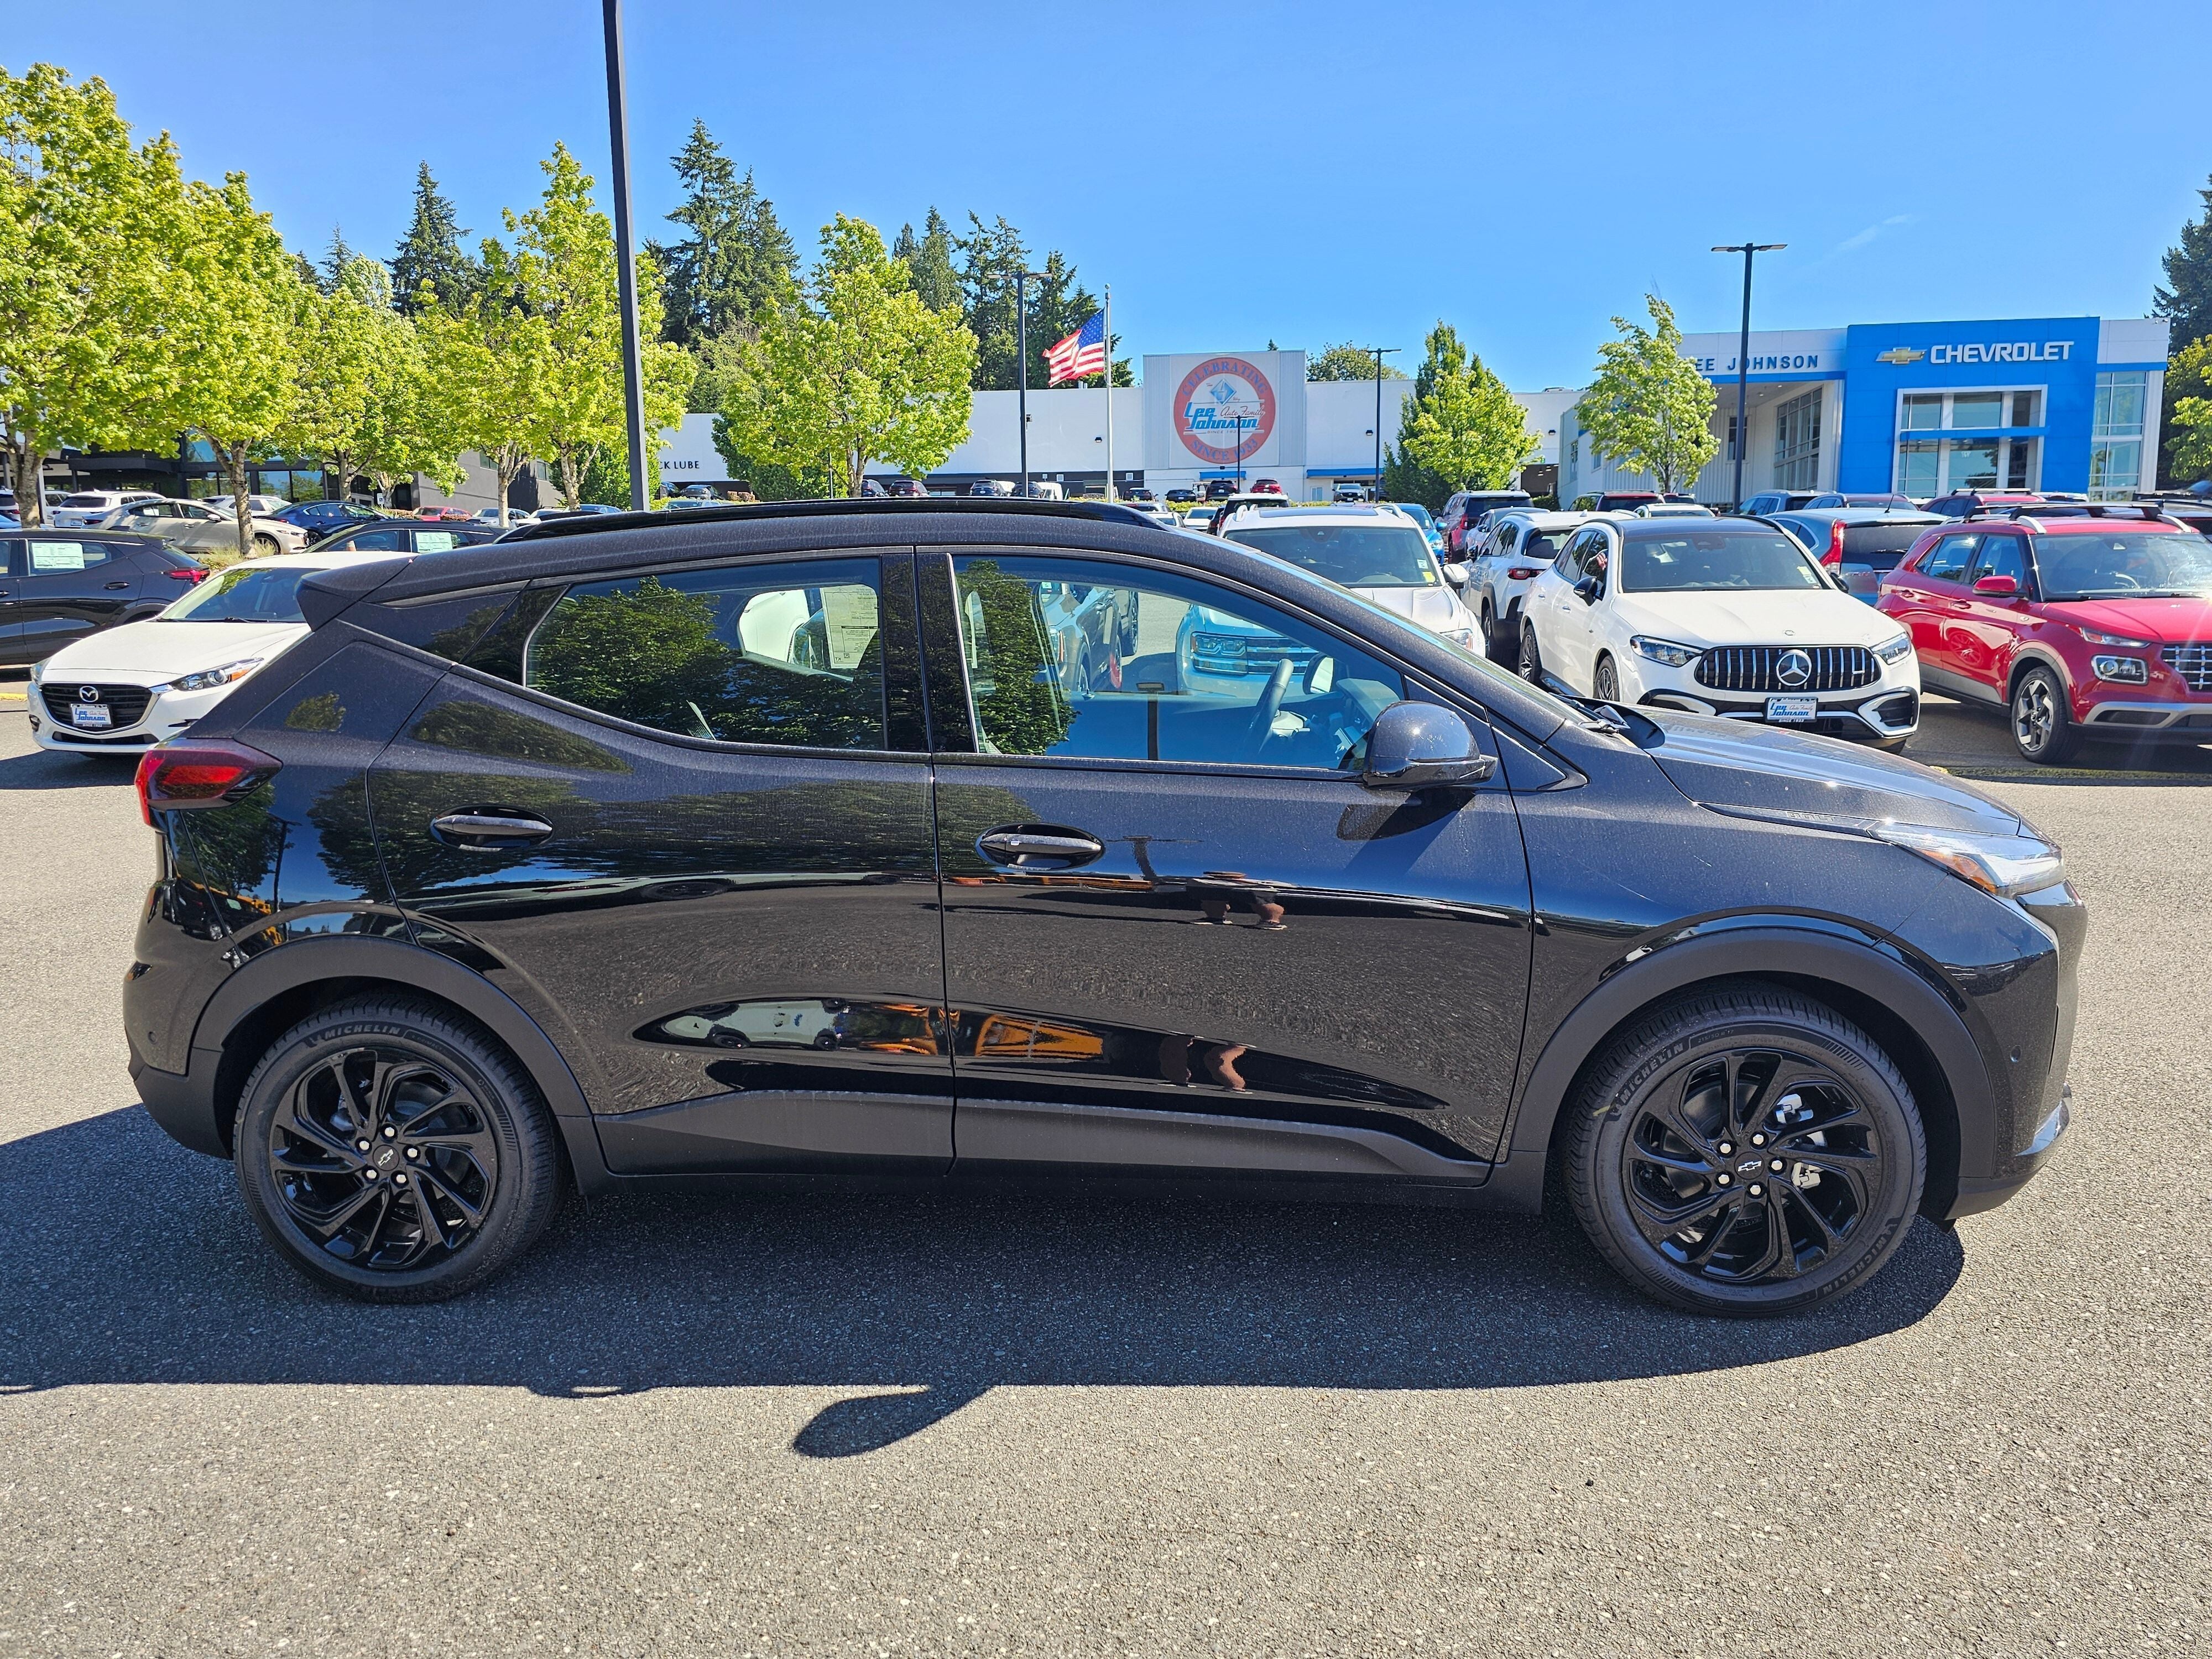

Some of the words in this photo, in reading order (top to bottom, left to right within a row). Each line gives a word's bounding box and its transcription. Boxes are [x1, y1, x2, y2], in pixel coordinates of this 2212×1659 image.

[1931, 341, 2074, 364] CHEVROLET
[1695, 358, 1715, 371] EE
[1182, 361, 1268, 397] CELEBRATING
[1183, 401, 1217, 418] Lee
[1220, 406, 1238, 417] Auto
[1240, 405, 1266, 420] Family
[1185, 414, 1259, 430] Johnson
[1191, 440, 1230, 461] SINCE
[1233, 438, 1258, 458] 1933
[674, 461, 700, 469] LUBE
[325, 1024, 401, 1040] MICHELIN
[1620, 1042, 1683, 1104] MICHELIN
[1698, 1032, 1719, 1043] 215/50
[1823, 1237, 1887, 1295] MICHELIN
